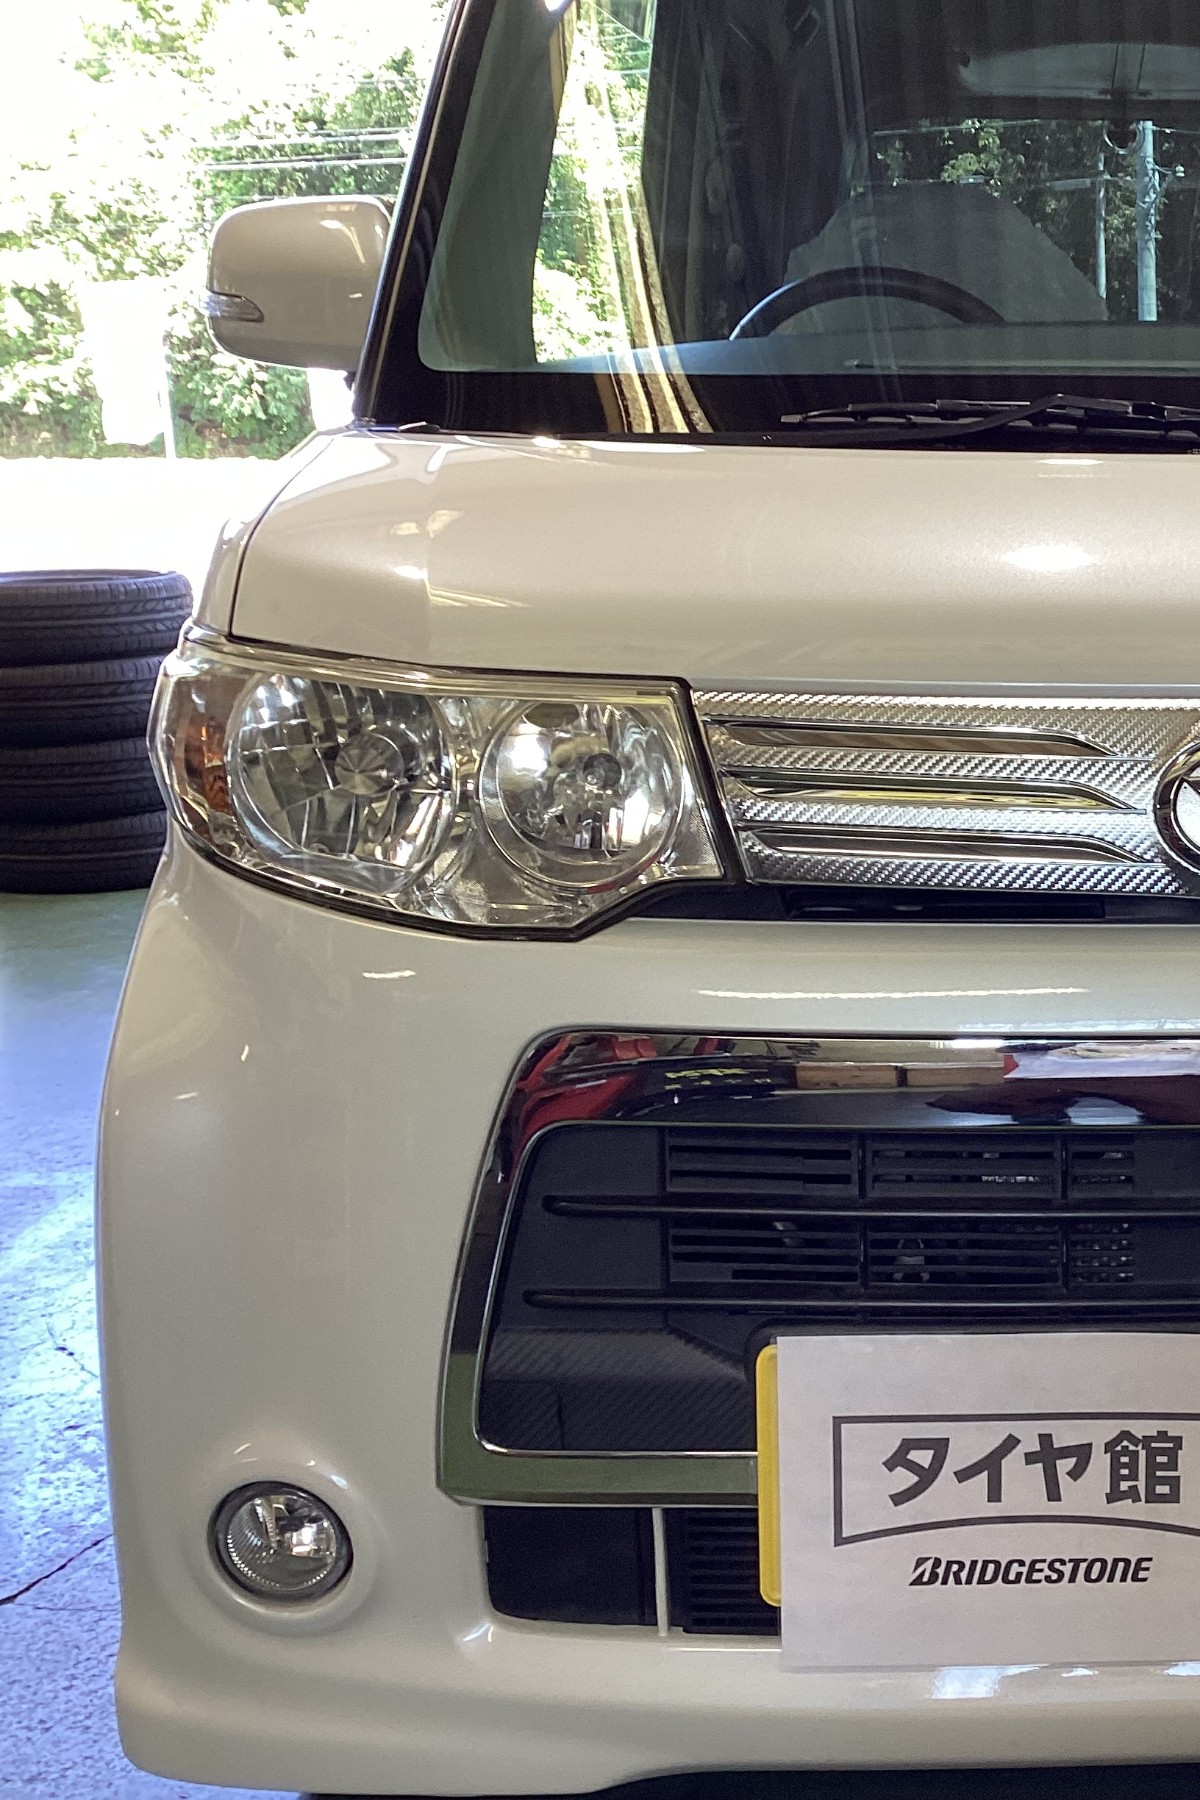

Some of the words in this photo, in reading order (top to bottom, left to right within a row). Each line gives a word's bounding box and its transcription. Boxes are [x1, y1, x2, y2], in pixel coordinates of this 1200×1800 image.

[882, 1430, 1183, 1506] タイヤ館
[908, 1556, 1153, 1587] BRIDGESTONE
